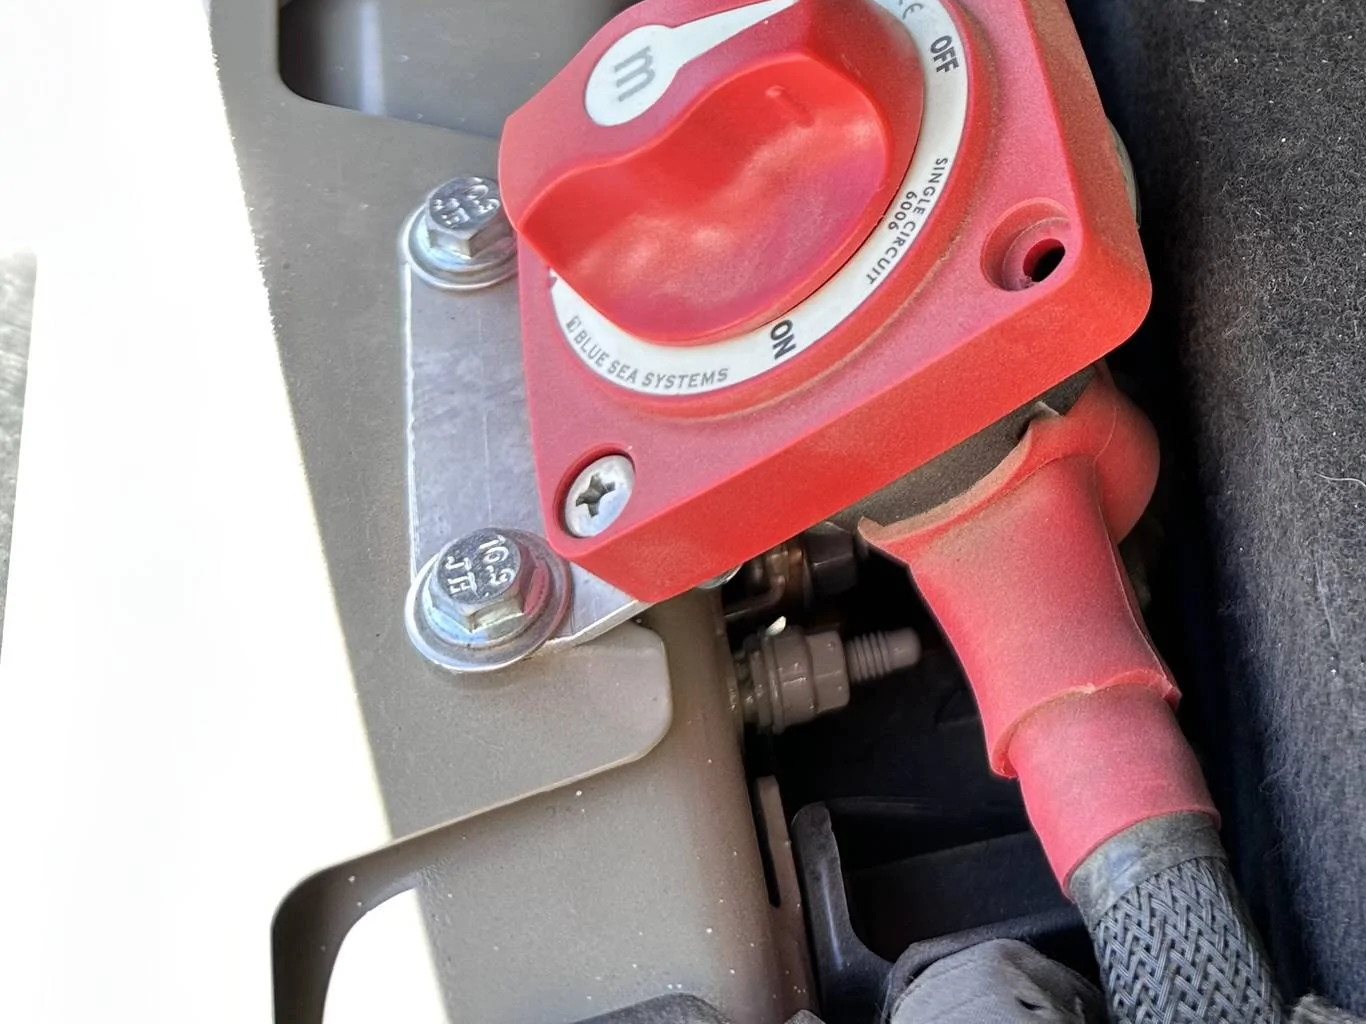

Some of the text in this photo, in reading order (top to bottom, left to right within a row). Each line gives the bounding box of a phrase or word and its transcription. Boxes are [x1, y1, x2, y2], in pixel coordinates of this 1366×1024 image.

[930, 35, 959, 73] OFF
[866, 157, 948, 285] SINGLE CIRCUIT
[888, 191, 917, 230] 6006
[574, 330, 729, 389] BLUE SEA SYSTEMS
[770, 319, 797, 360] ON
